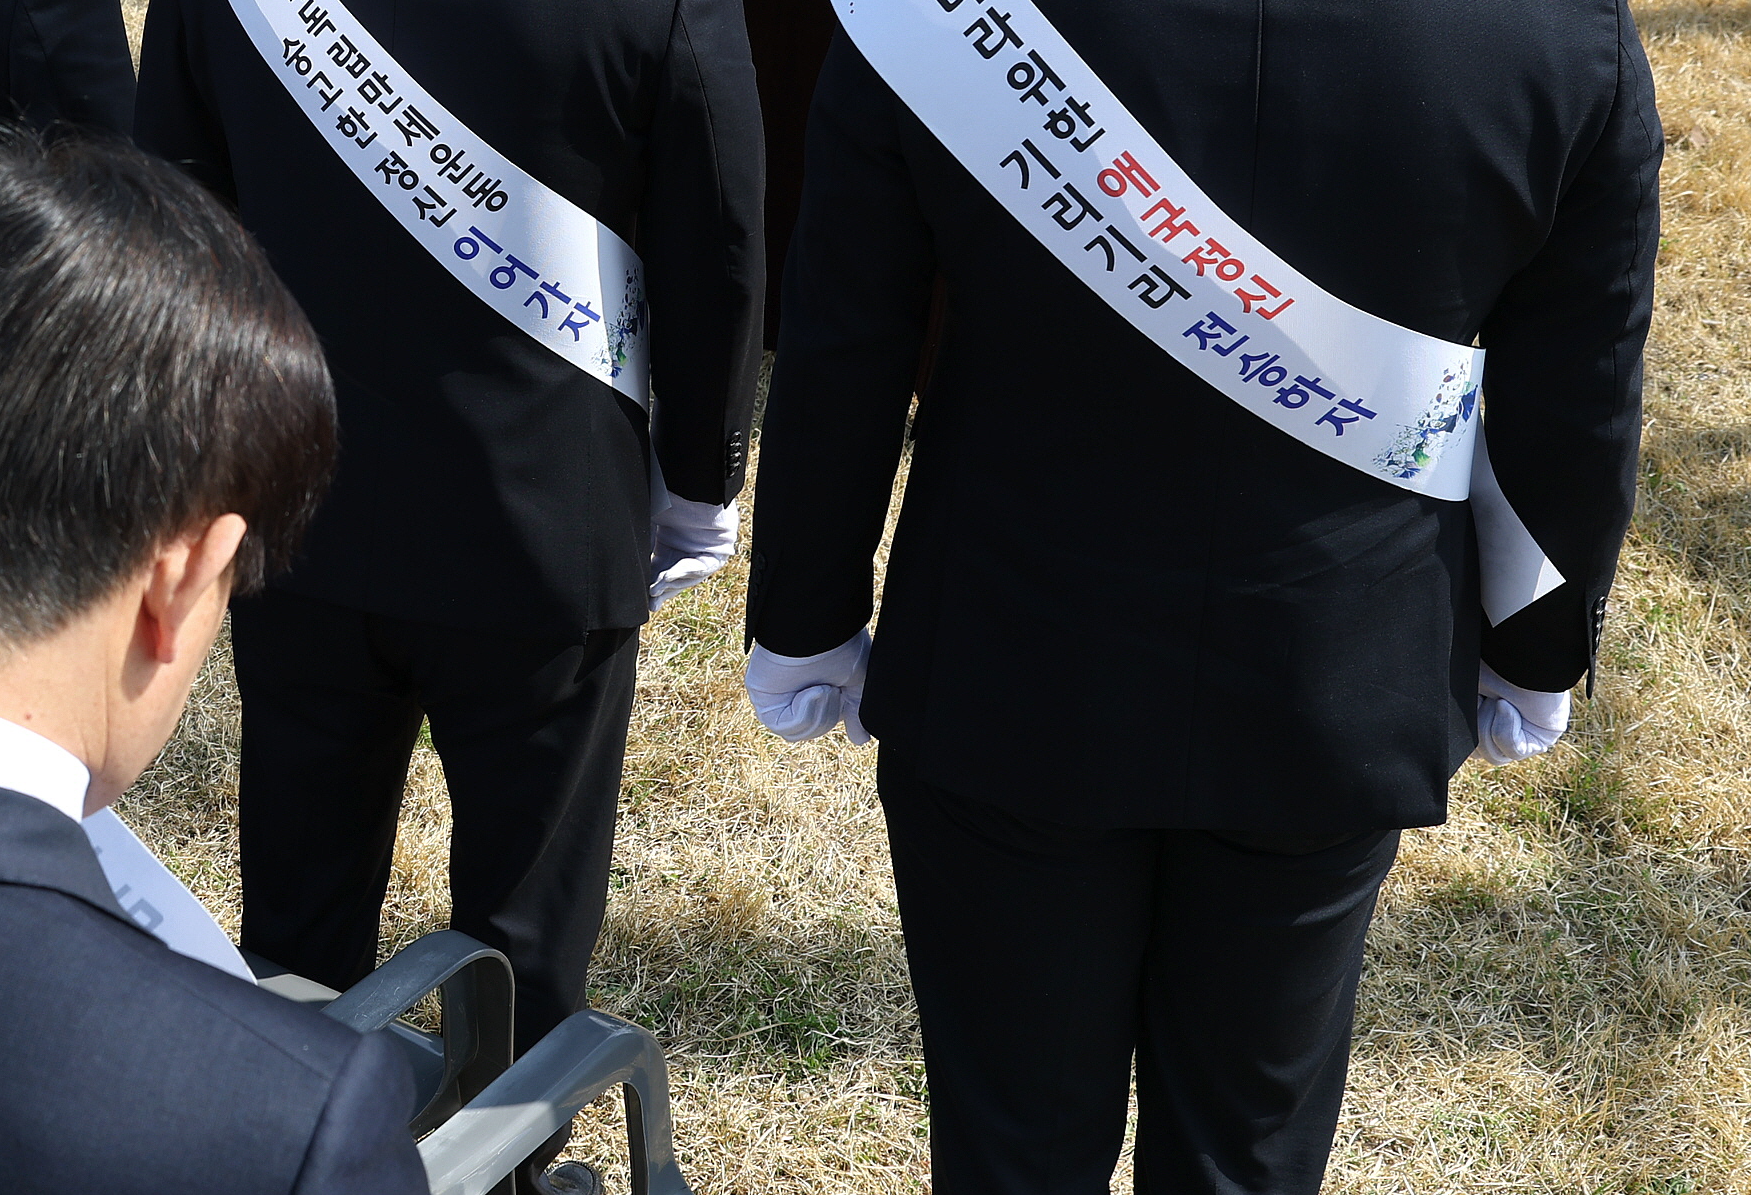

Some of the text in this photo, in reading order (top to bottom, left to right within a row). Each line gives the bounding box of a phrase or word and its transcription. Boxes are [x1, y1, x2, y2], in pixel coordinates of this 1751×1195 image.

[281, 37, 602, 342] 숭고한 정신 이어가자
[999, 138, 1378, 437] 기리기리 전승하자
[1096, 150, 1295, 320] 애국정신
